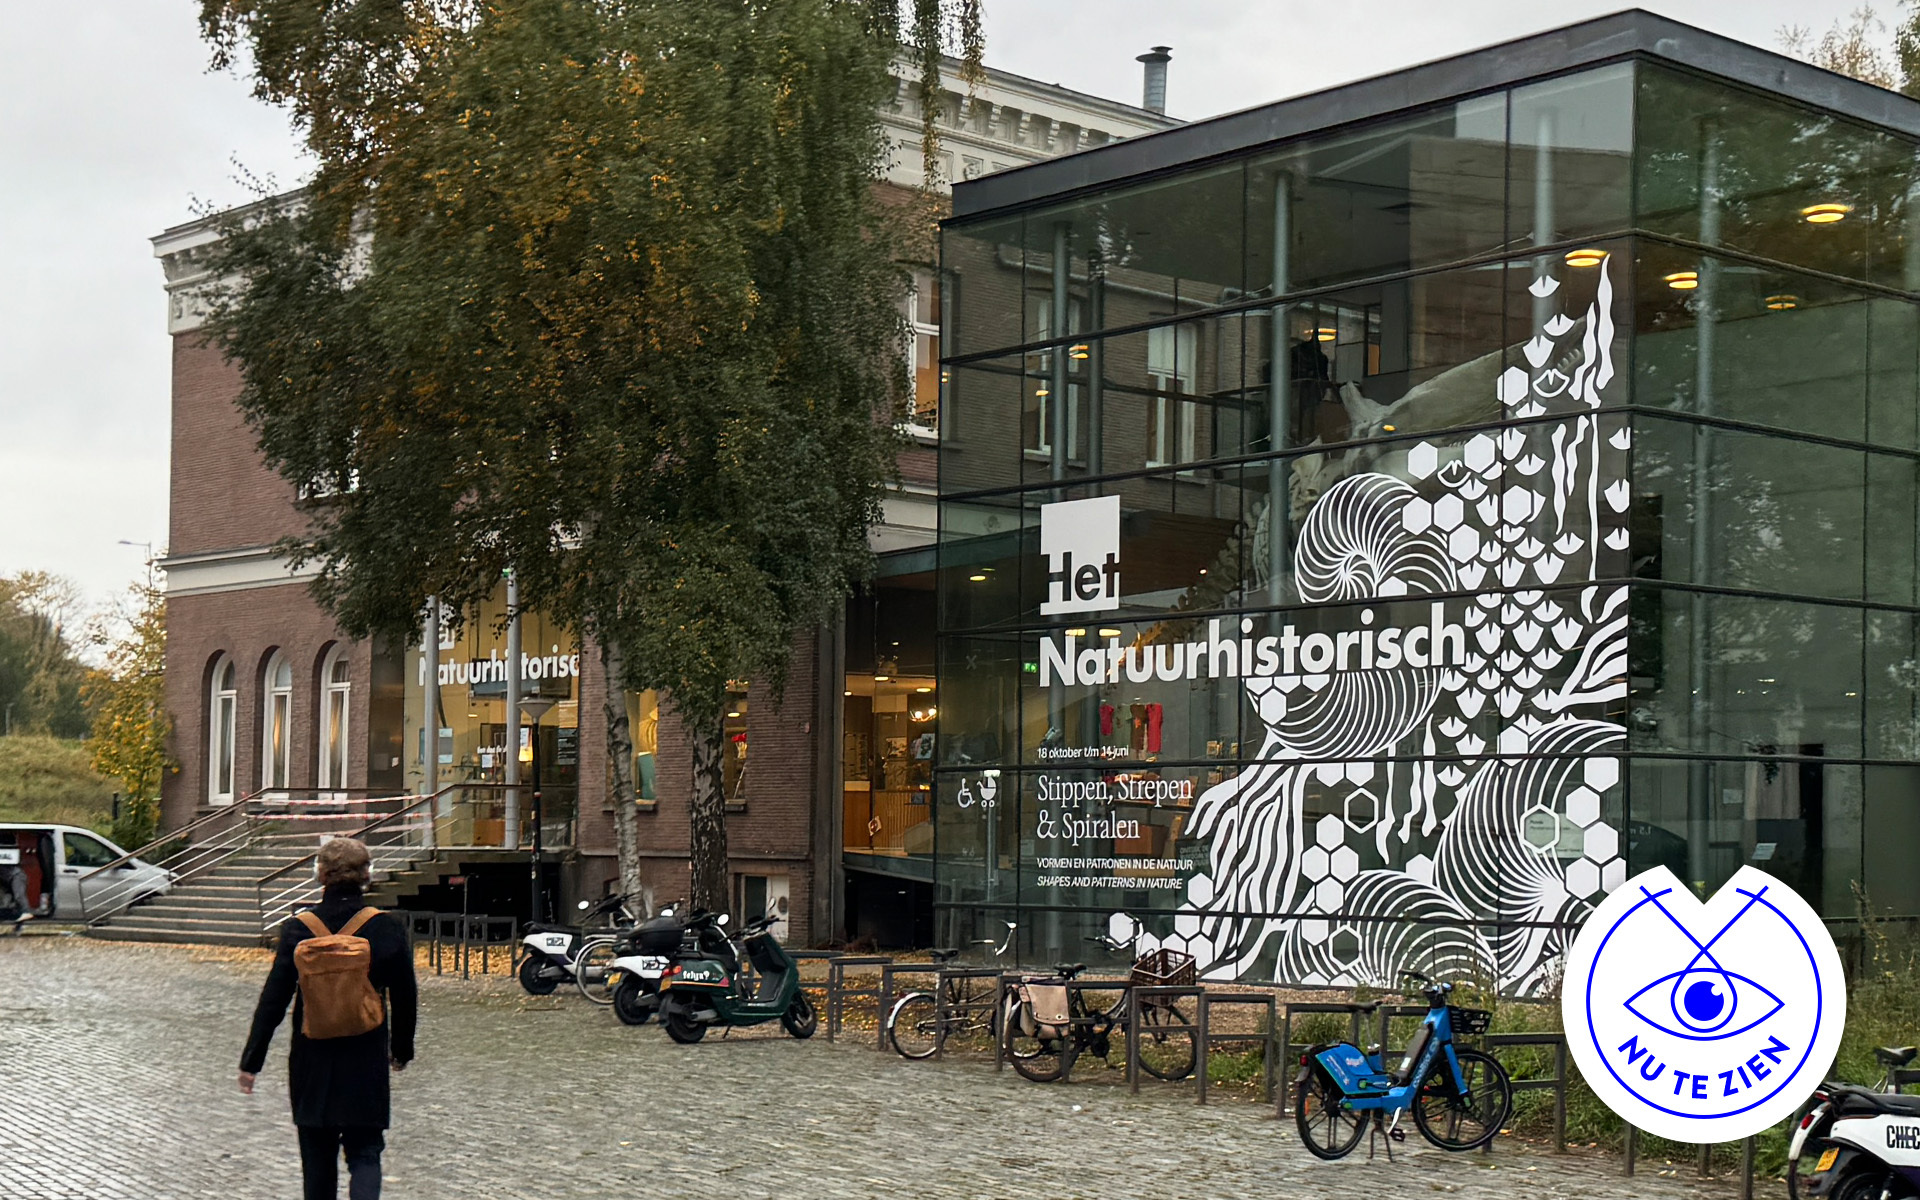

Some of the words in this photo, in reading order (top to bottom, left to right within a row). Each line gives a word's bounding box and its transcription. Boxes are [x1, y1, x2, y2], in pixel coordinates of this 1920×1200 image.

[1040, 602, 1465, 687] Natuurhistorisch
[419, 645, 579, 686] atuurhitorisc
[1037, 747, 1048, 759] 18
[1049, 746, 1081, 758] oktober
[1084, 746, 1099, 758] t/m
[1037, 774, 1114, 808] Stippen,
[1118, 773, 1193, 808] Strepen
[1036, 809, 1058, 839] &
[1062, 810, 1140, 847] Spiralen
[1037, 857, 1073, 869] VORMEN
[1074, 858, 1085, 869] EN
[1086, 858, 1132, 870] PATRONEN
[1132, 858, 1142, 869] IN
[1143, 858, 1156, 870] DE
[1156, 858, 1193, 871] NATUUR
[1037, 875, 1071, 887] SHAPES
[1071, 876, 1090, 887] AND
[1091, 876, 1136, 889] PATTERNS
[1136, 877, 1146, 888] IN
[1146, 877, 1183, 890] NATURE
